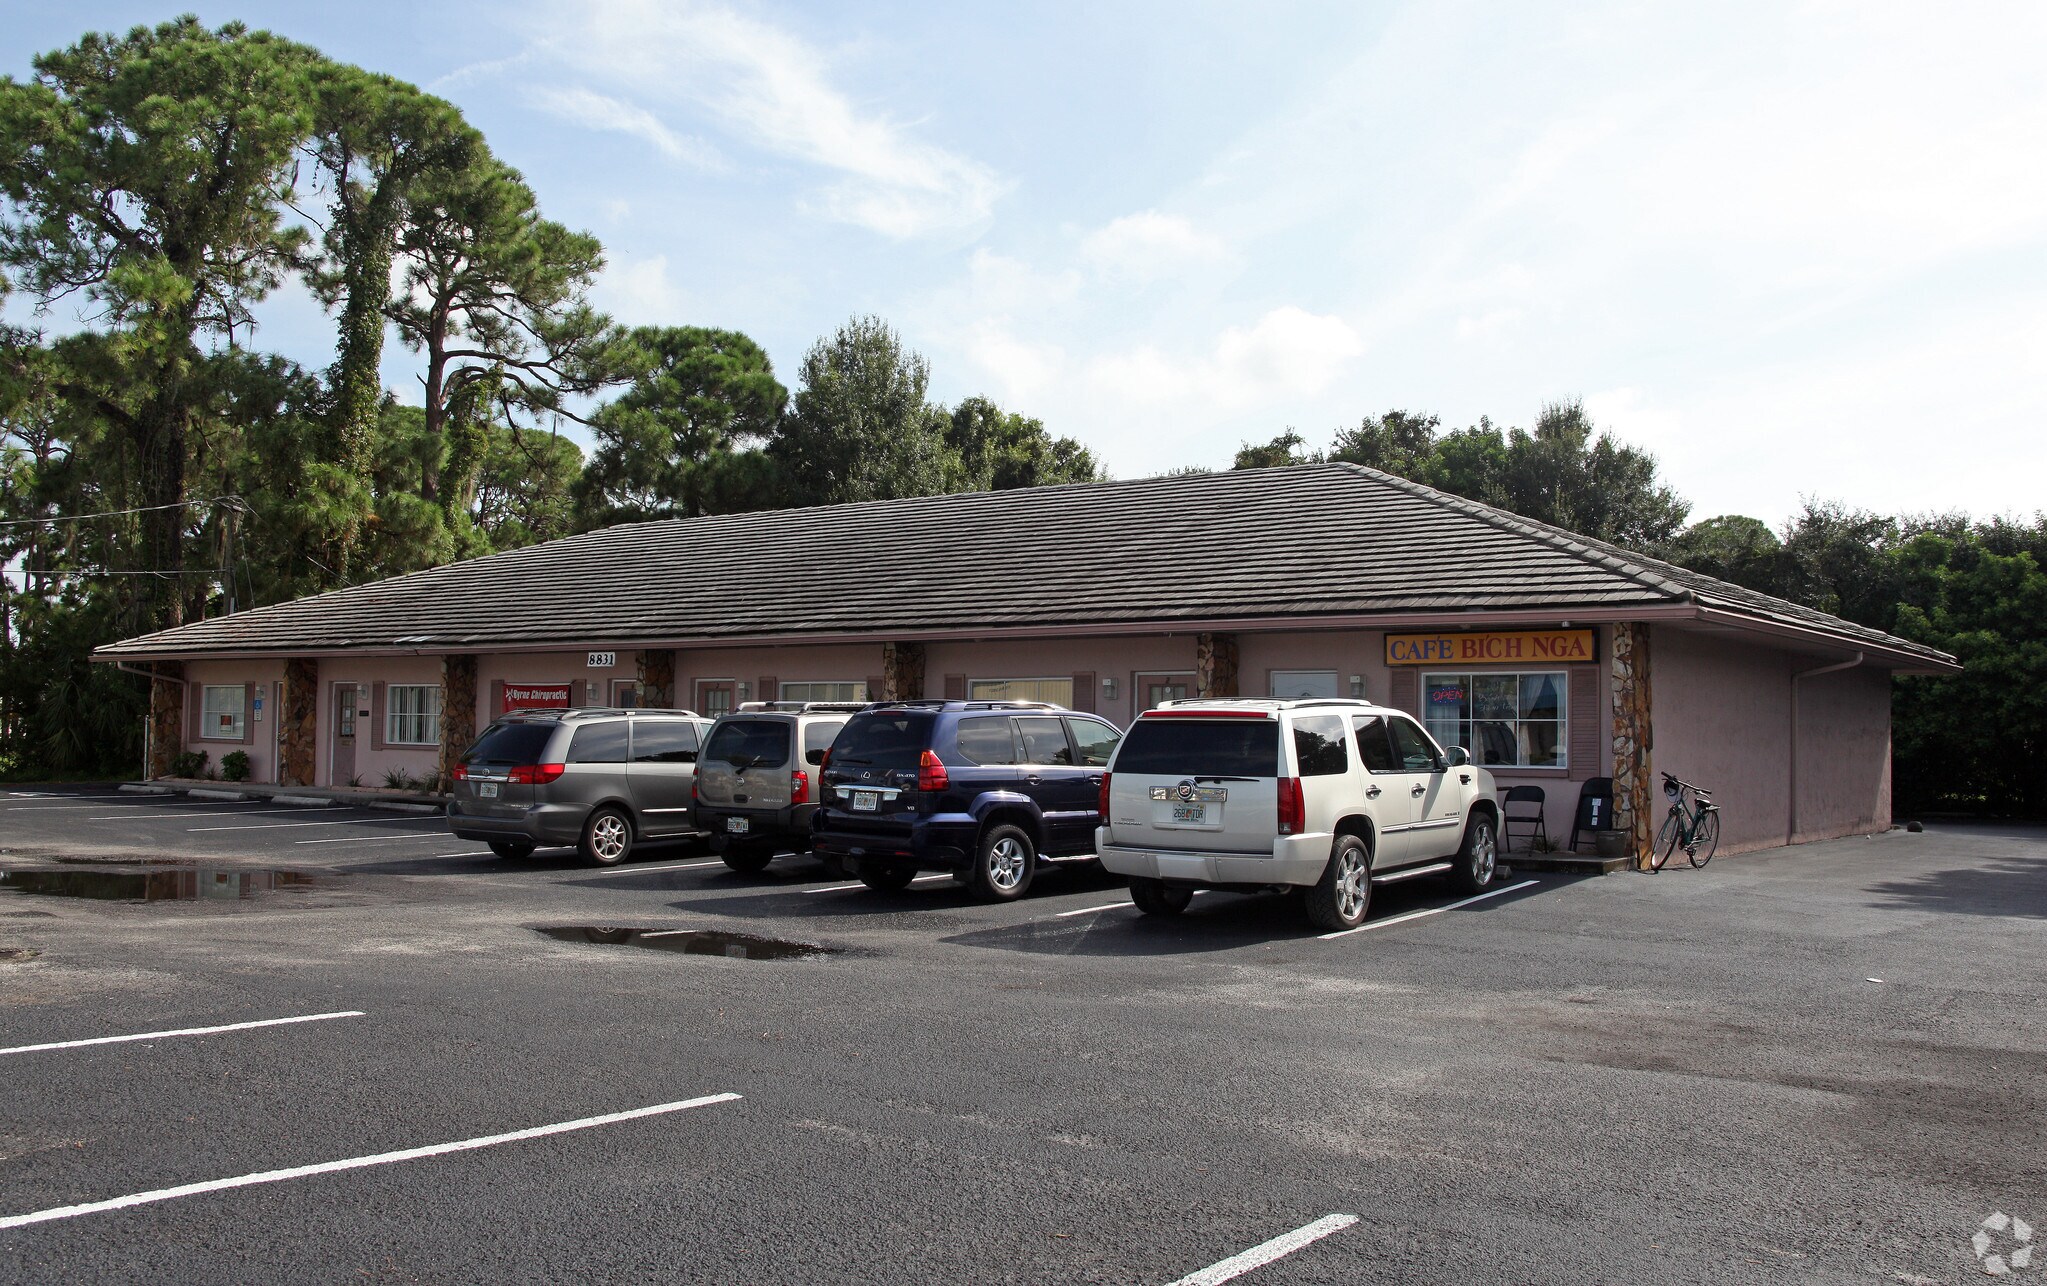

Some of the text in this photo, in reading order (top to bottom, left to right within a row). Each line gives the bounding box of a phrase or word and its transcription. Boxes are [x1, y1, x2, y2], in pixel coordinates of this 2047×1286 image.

[1531, 636, 1587, 657] NGA
[588, 653, 614, 665] 8831
[531, 684, 567, 701] Chiropractic
[1432, 689, 1464, 701] OPEN
